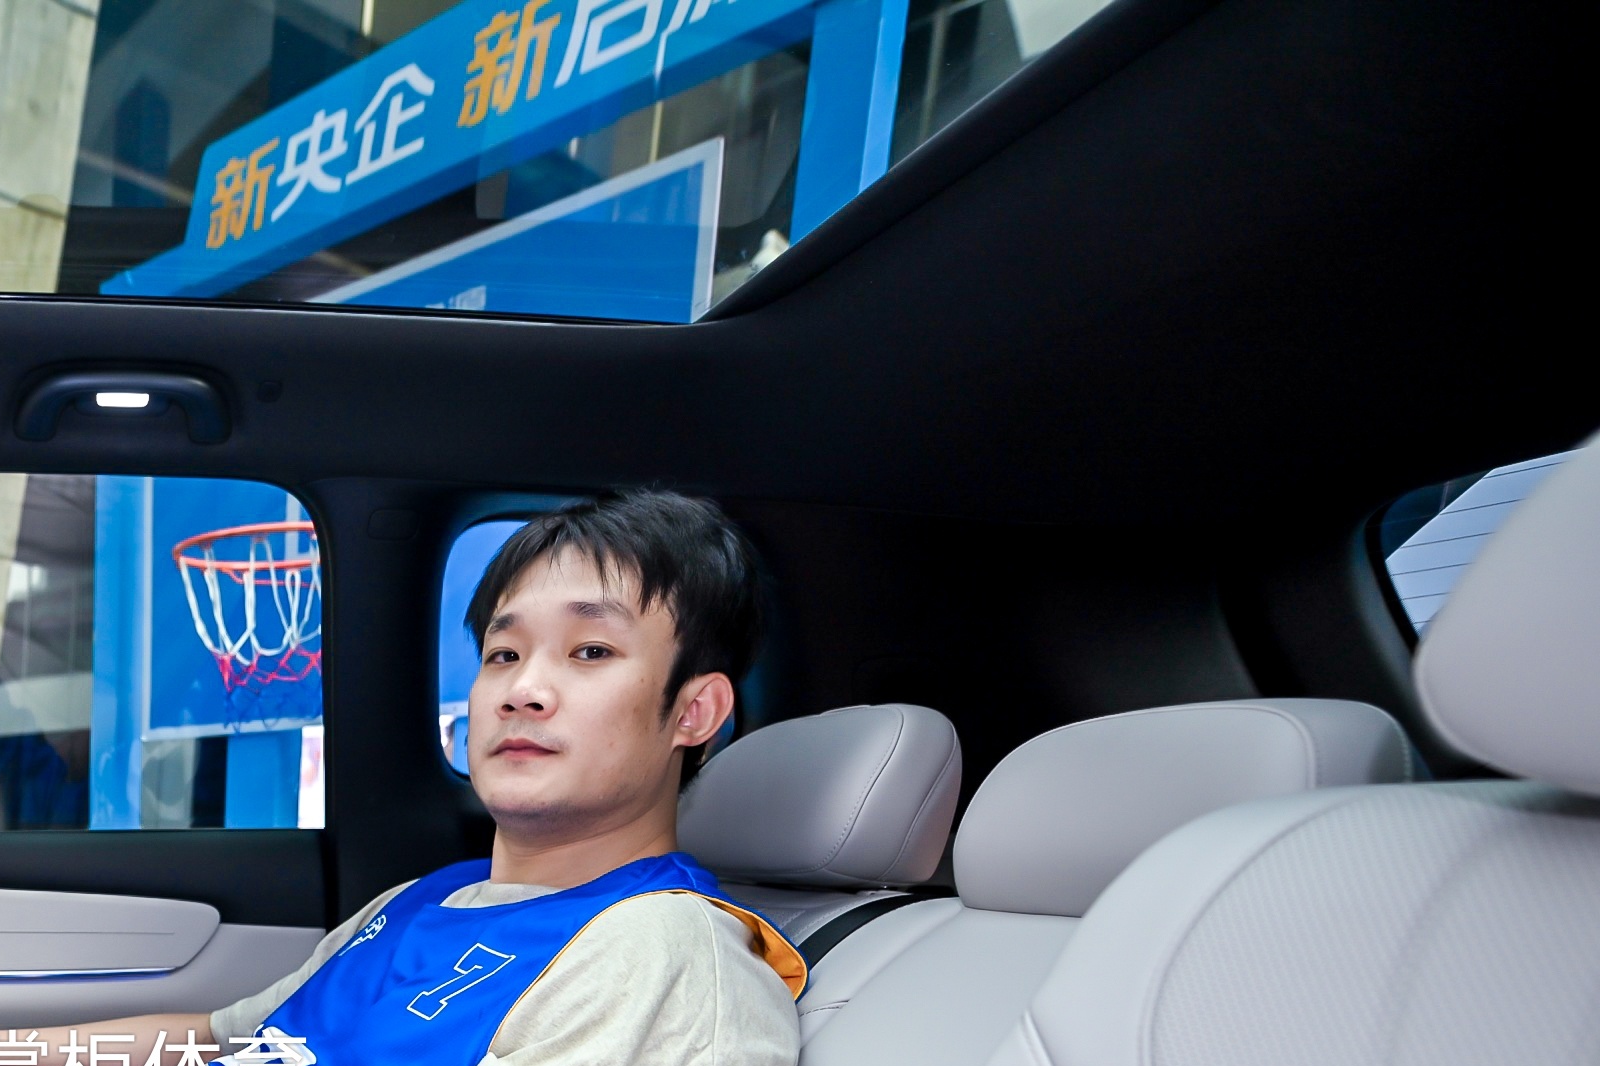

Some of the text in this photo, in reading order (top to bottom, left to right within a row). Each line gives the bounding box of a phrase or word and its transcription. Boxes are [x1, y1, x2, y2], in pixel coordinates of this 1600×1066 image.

[206, 62, 436, 249] 新央企
[406, 942, 517, 1021] 7
